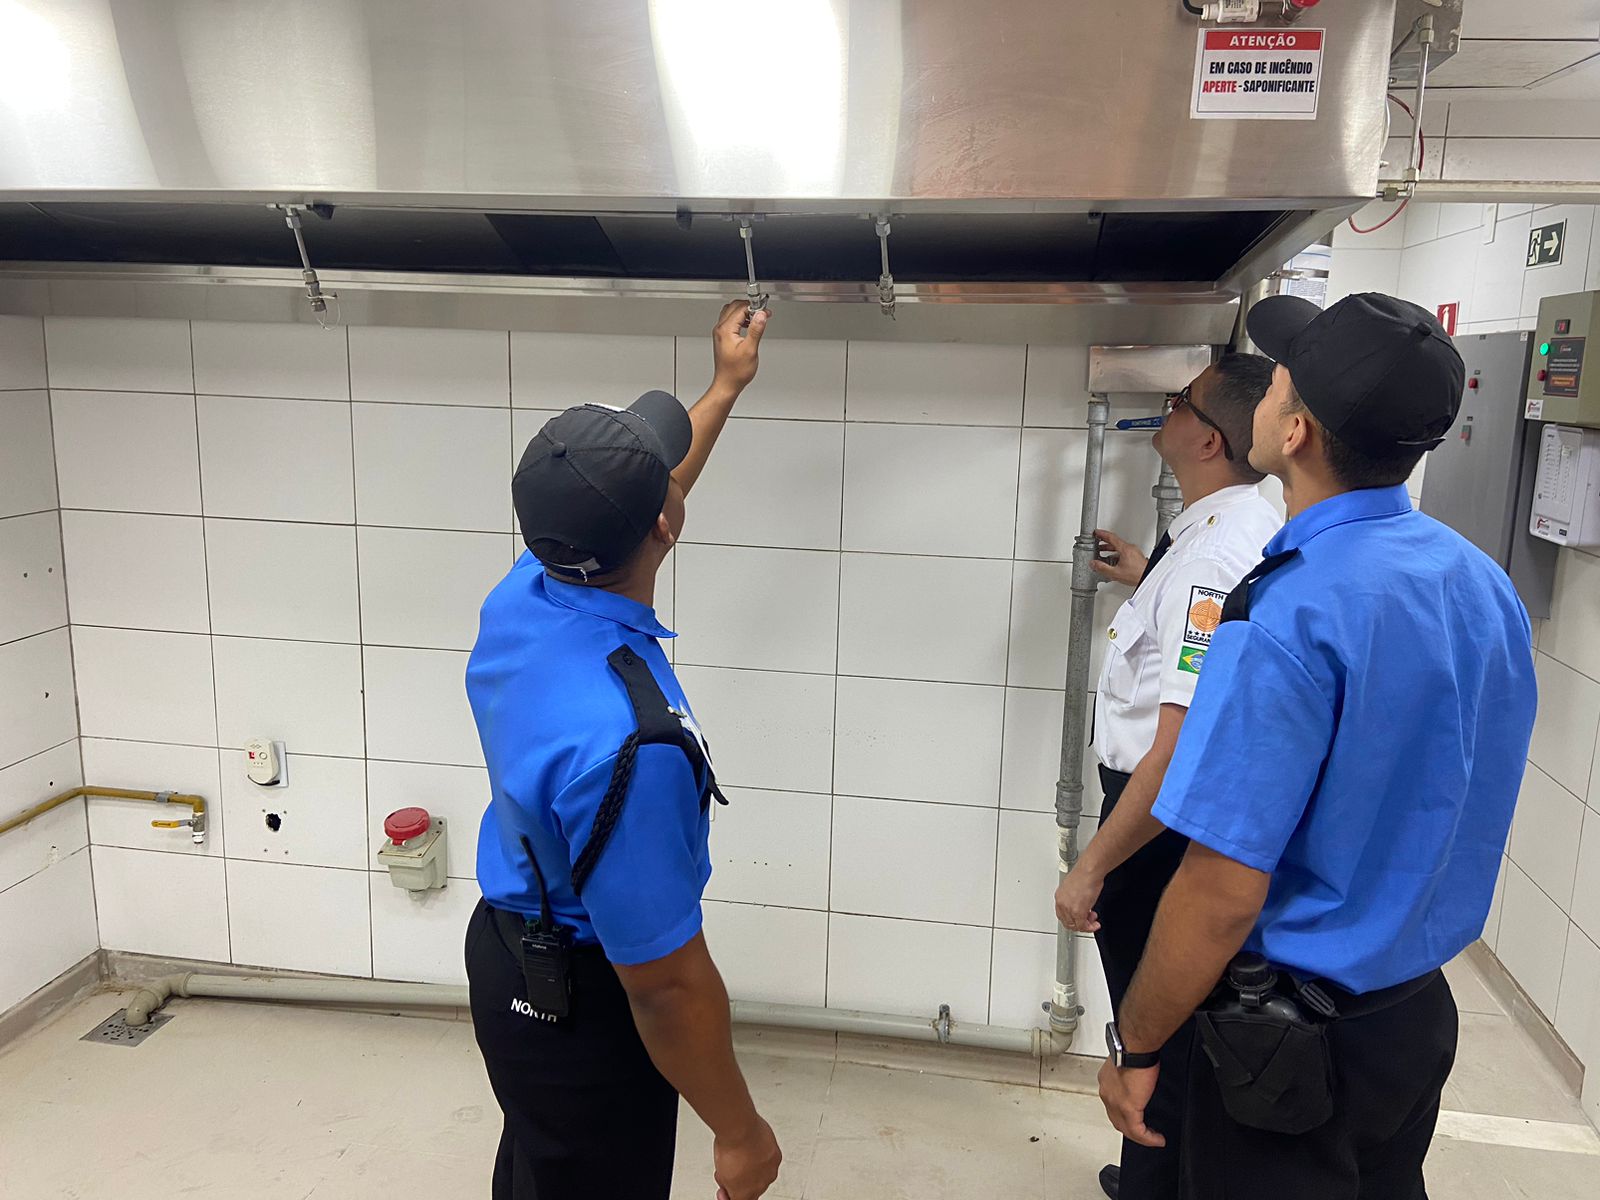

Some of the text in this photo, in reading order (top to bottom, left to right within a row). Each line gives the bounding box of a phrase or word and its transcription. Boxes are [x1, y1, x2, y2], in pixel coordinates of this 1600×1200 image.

[1229, 33, 1297, 49] ATENÇÃO
[1209, 58, 1313, 74] EM CASO DE INCÊNDIO
[1197, 589, 1224, 600] NORTH
